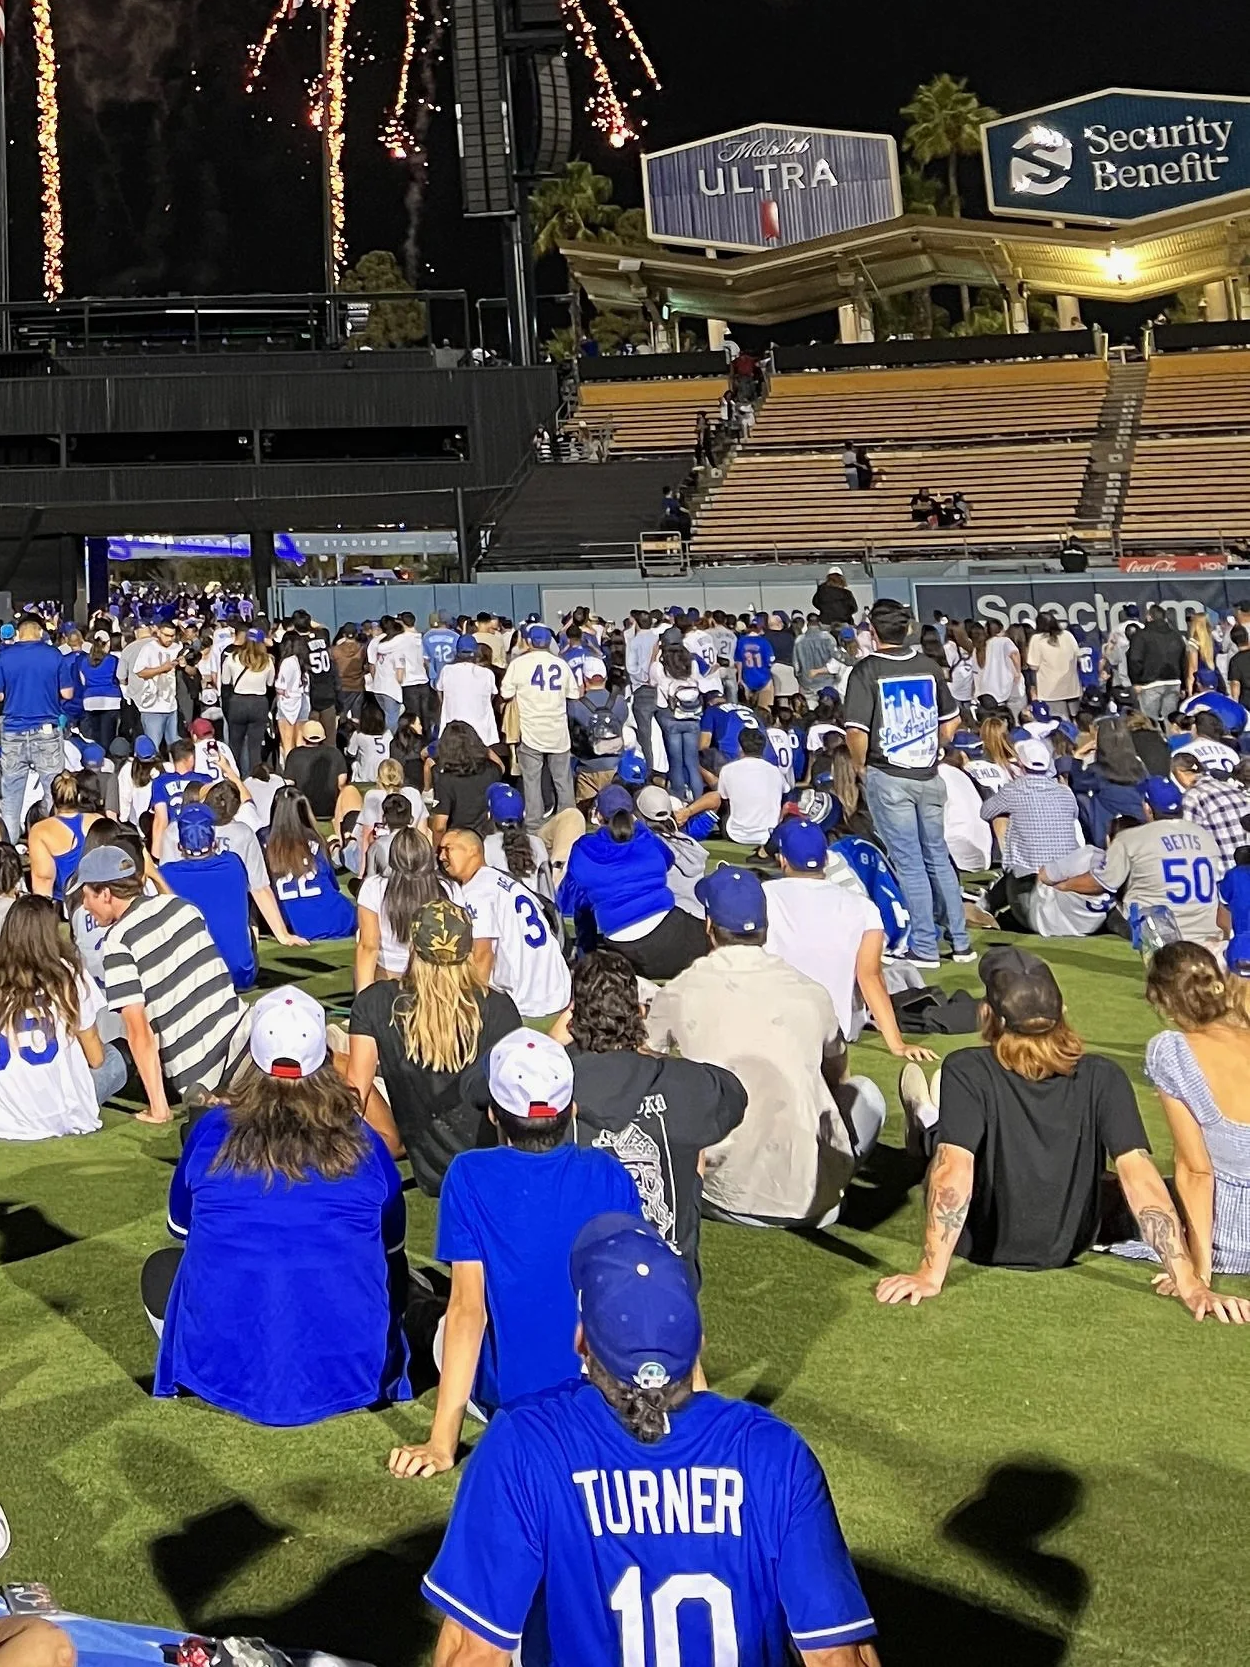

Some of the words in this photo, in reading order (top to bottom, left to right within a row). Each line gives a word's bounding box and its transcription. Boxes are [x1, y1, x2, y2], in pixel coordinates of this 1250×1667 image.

[1084, 115, 1233, 155] Security
[698, 157, 839, 197] ULTRA
[1091, 152, 1221, 191] Benefit
[308, 650, 330, 674] 50
[434, 644, 453, 663] 42
[531, 664, 562, 692] 42
[374, 737, 385, 754] 5
[1160, 835, 1202, 852] BETTS
[1162, 857, 1214, 904] 50
[571, 1466, 745, 1538] TURNER
[609, 1564, 739, 1667] 10
